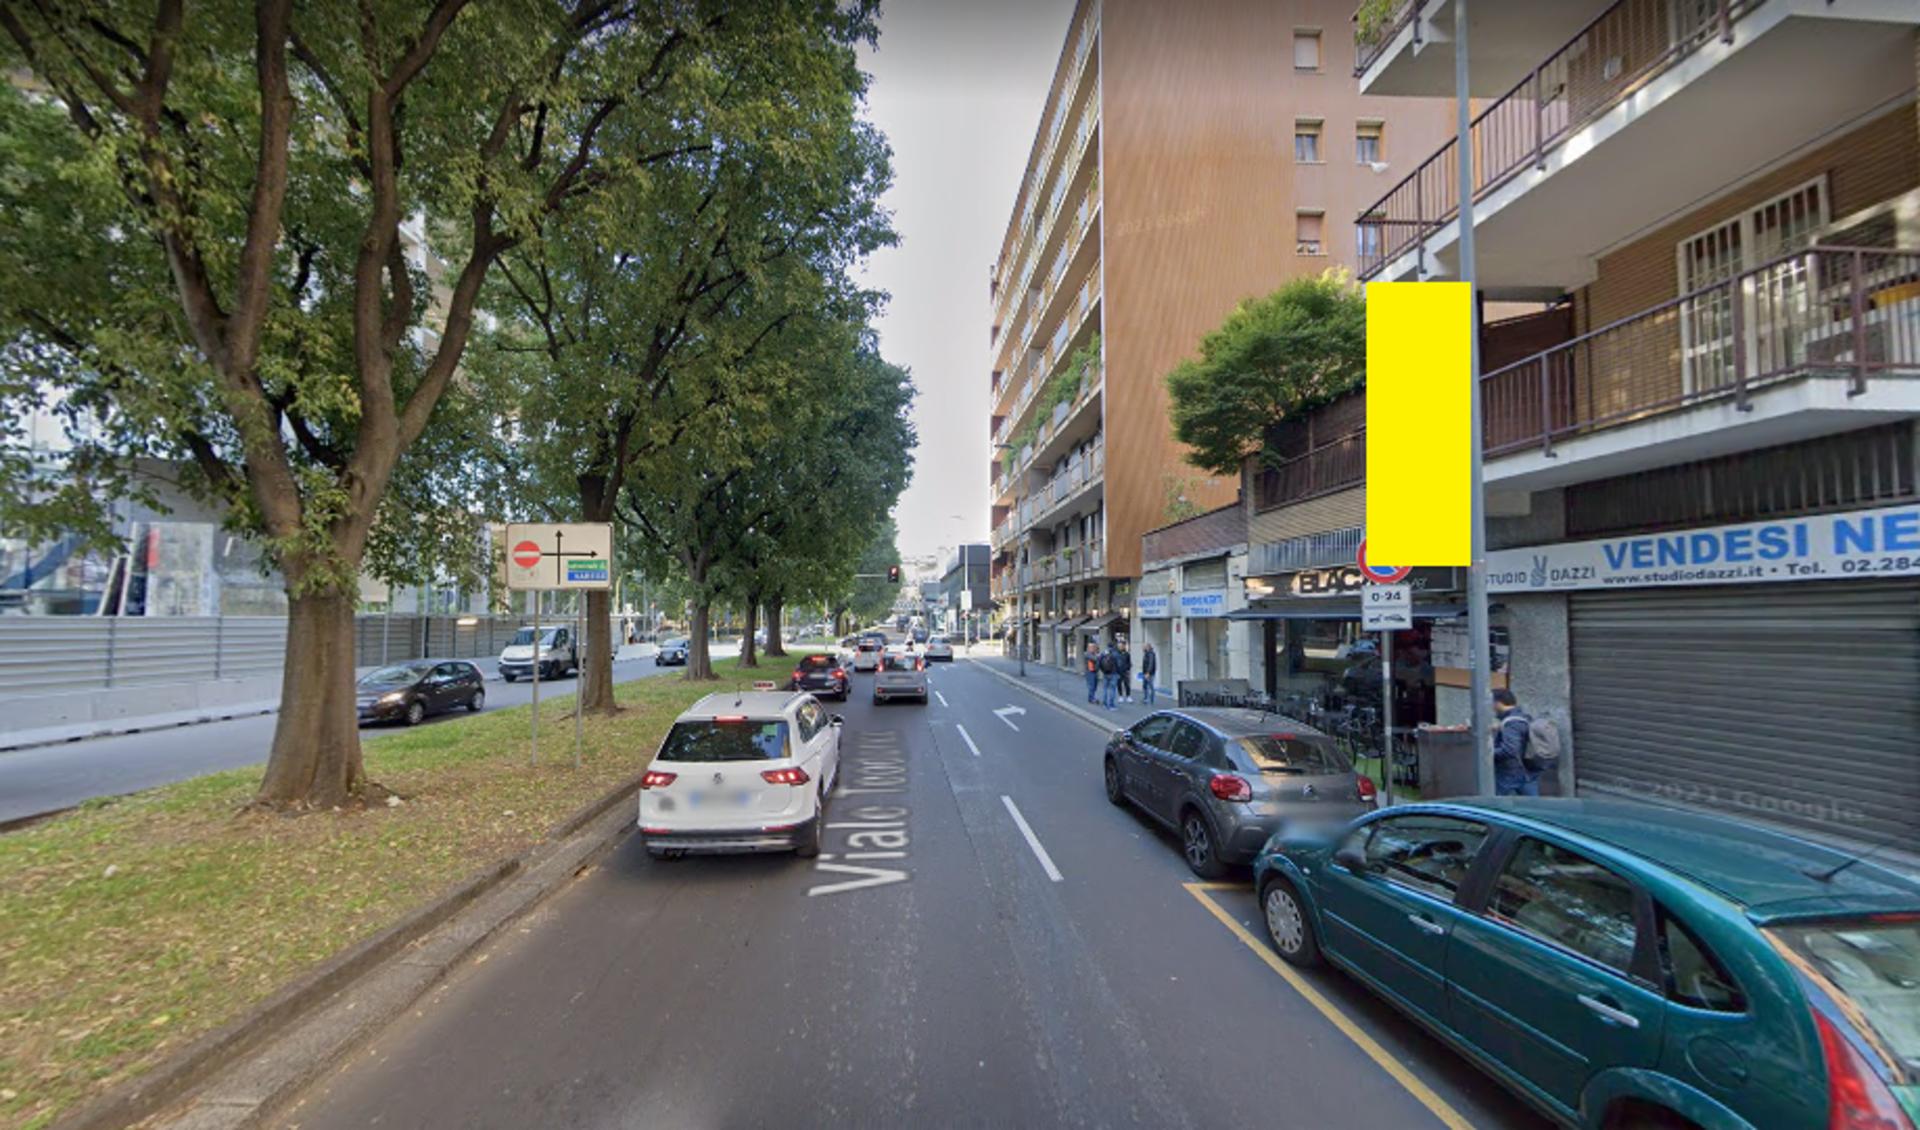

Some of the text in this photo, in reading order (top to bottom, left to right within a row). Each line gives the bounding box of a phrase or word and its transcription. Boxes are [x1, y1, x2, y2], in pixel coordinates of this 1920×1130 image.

[1603, 511, 1920, 570] VENDESI NE
[1298, 566, 1371, 594] BLAC
[1550, 566, 1596, 582] DAZZI
[1602, 565, 1764, 584] www.studiodazzi.it
[1786, 561, 1826, 575] Tel.
[1371, 590, 1402, 602] 0-24
